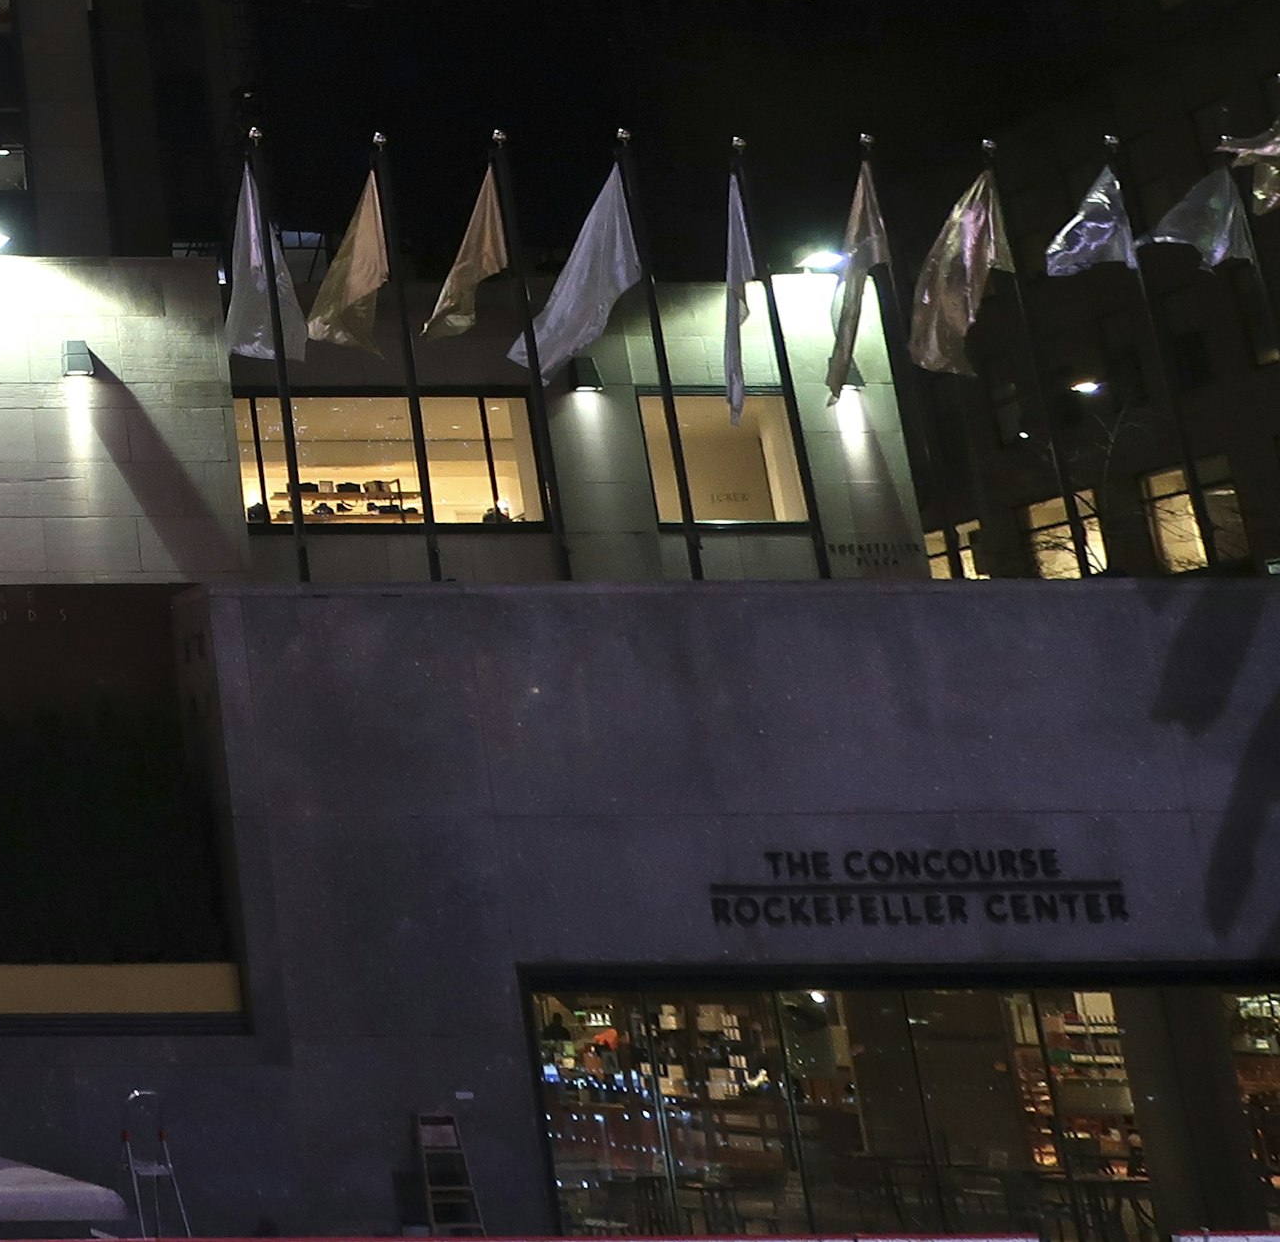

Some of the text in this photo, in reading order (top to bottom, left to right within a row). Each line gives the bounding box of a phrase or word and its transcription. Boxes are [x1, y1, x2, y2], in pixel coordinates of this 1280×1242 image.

[765, 848, 1062, 879] THE CONCOURSE
[711, 893, 1131, 925] ROCKEFELLER CENTER
